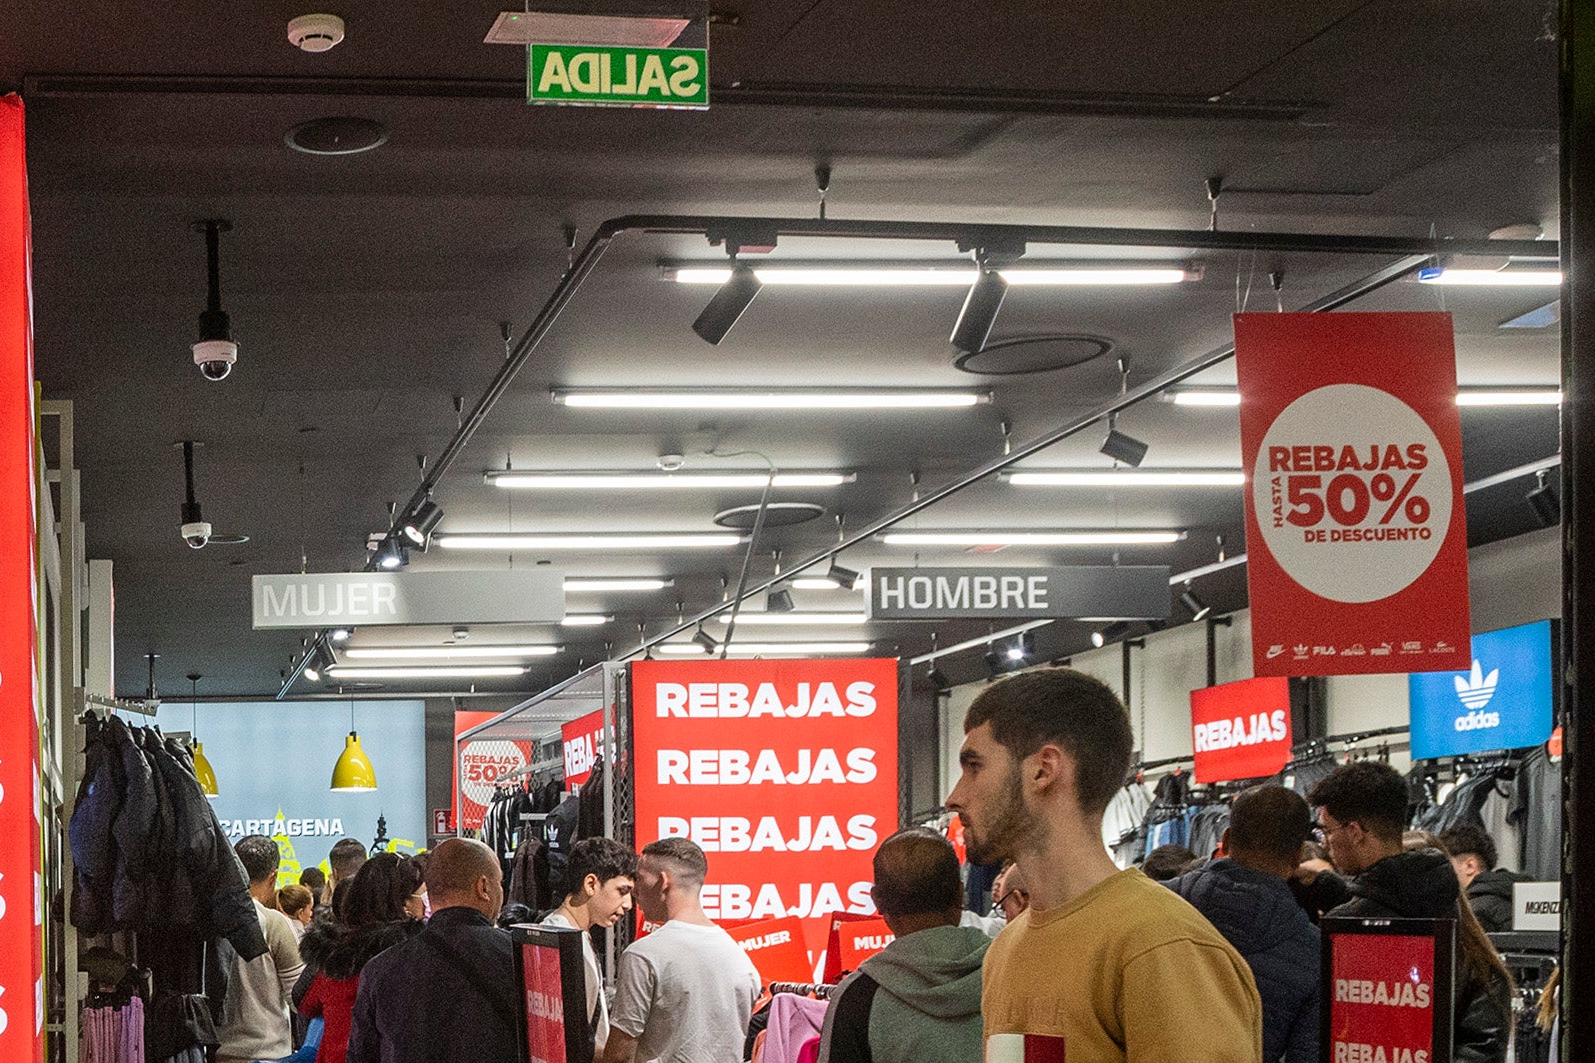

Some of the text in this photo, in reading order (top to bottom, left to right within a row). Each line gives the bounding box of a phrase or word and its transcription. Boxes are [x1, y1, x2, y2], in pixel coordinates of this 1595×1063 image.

[1269, 444, 1428, 473] REBAJAS
[1273, 472, 1431, 529] HASTA 50%
[1304, 528, 1432, 543] DE DESCUENTO
[262, 581, 398, 617] MUJER
[880, 575, 1050, 611] HOMBRE
[656, 682, 876, 718] REBAJAS
[1193, 709, 1286, 752] REBAJAS
[1454, 710, 1500, 732] adidas
[657, 748, 877, 784] REBAJAS
[221, 818, 345, 837] CARTAGENA
[658, 814, 877, 852] REBAJAS
[739, 930, 792, 952] MUJER
[854, 934, 896, 951] MUJ
[528, 990, 564, 1024] REBAJA
[1335, 978, 1431, 1011] REBAJAS
